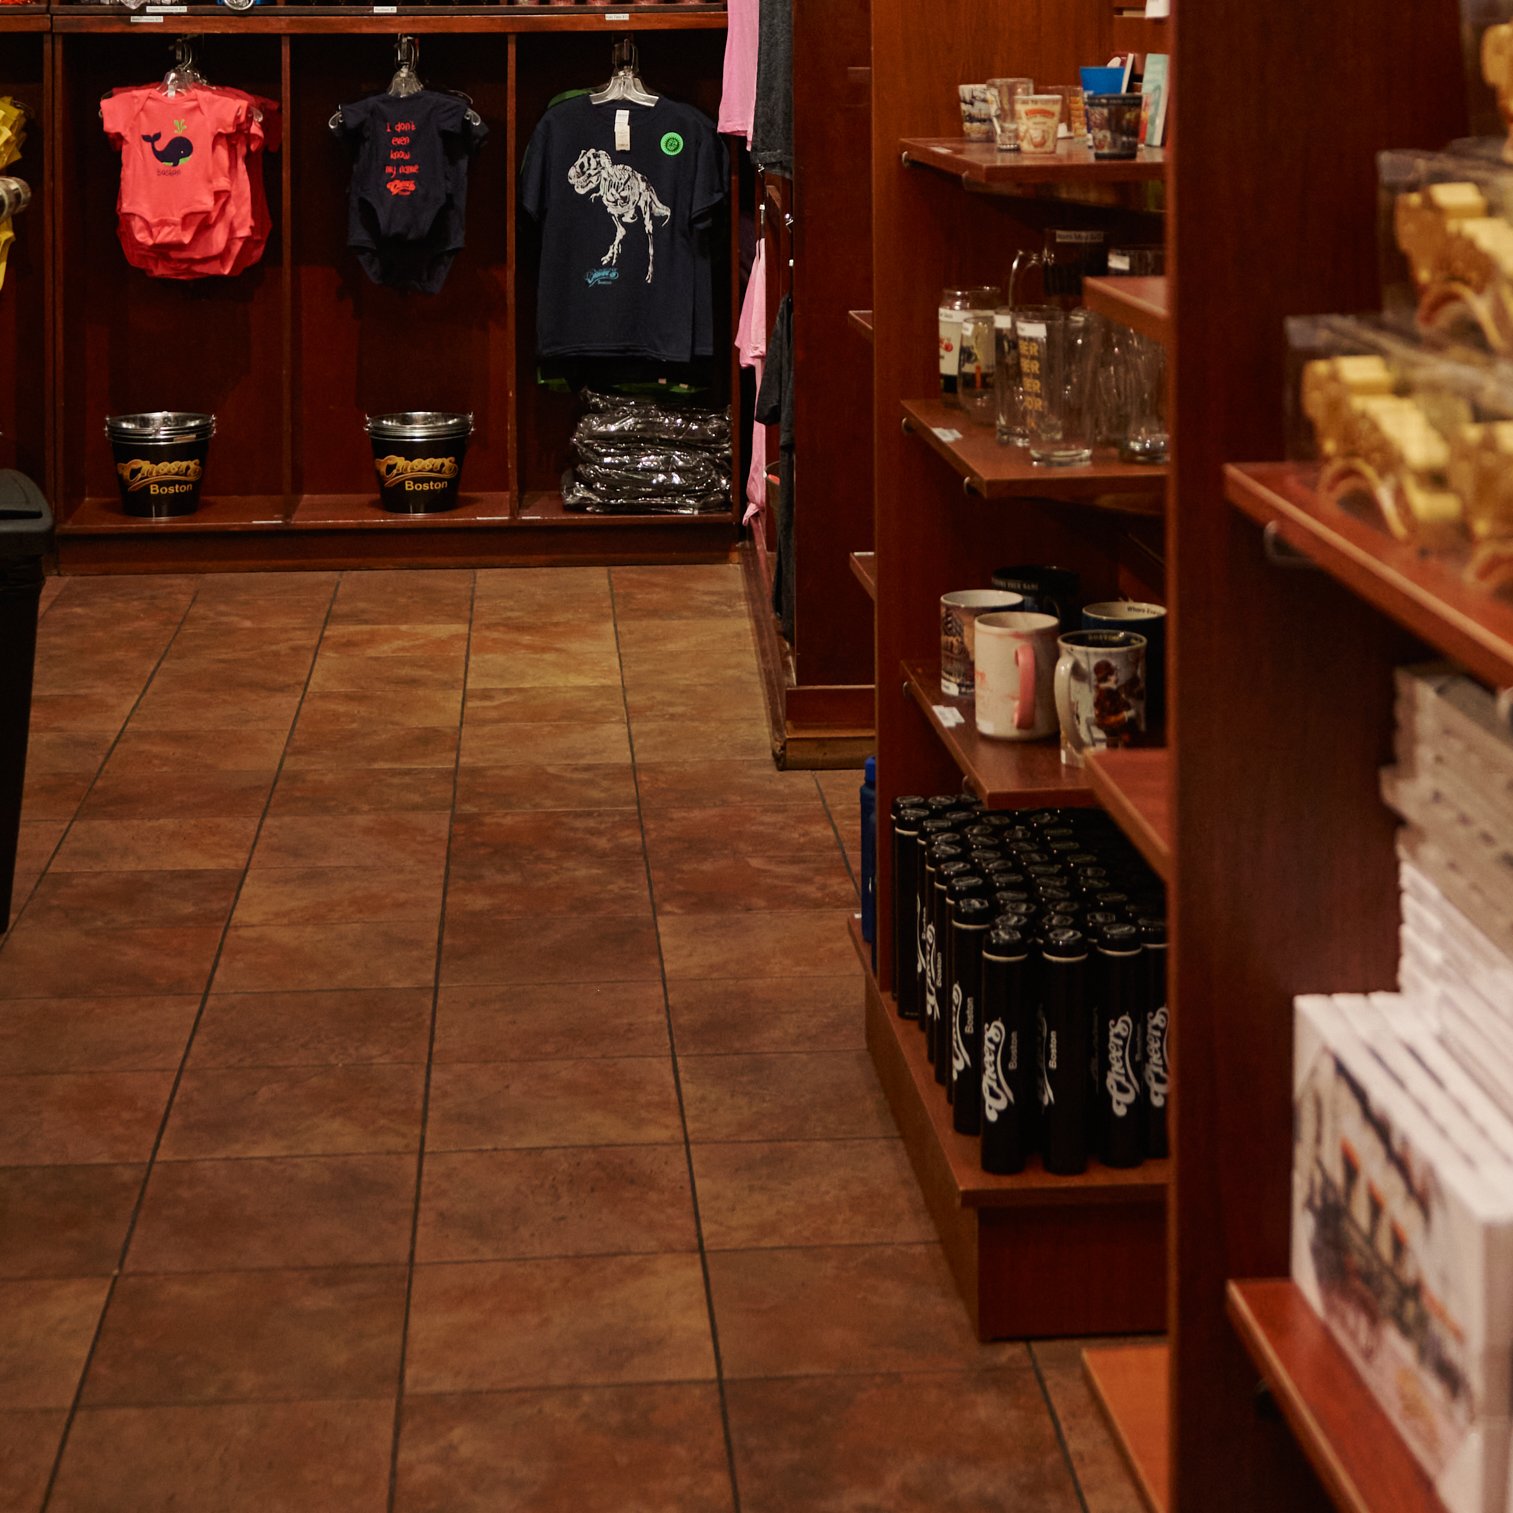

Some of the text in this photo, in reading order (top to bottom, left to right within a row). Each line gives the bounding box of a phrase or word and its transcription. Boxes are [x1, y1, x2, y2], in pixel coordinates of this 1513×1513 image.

[391, 136, 410, 145] even
[394, 121, 416, 133] don't
[385, 164, 419, 178] my name
[390, 149, 411, 160] know
[116, 458, 203, 491] Cheers
[373, 454, 459, 487] Cheers
[404, 480, 448, 491] Boston
[149, 483, 193, 495] Boston
[964, 997, 974, 1034] Boston
[1008, 1030, 1018, 1070] Boston
[1048, 1030, 1057, 1070] Boston
[1106, 1010, 1141, 1118] Cheers
[982, 1017, 1015, 1123] Cheers
